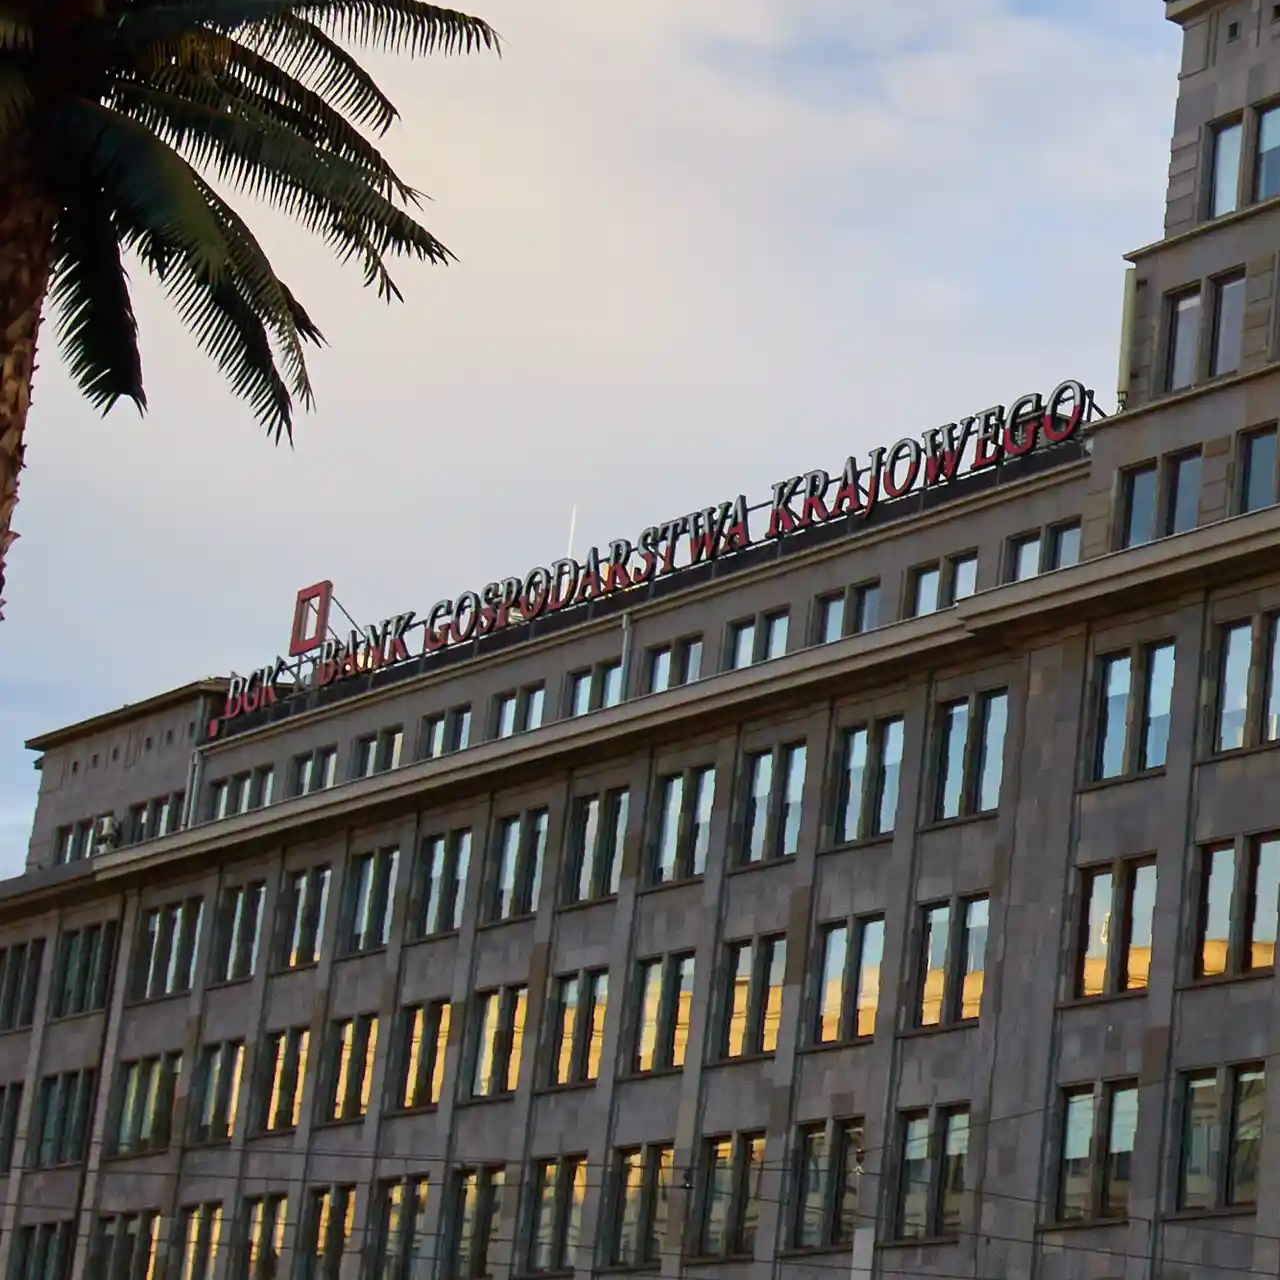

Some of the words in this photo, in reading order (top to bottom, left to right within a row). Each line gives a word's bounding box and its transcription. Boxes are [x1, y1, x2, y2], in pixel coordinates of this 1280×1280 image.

[224, 654, 288, 719] BGK
[316, 611, 416, 686] BANK
[423, 493, 751, 650] GOSPODARSTWA
[765, 379, 1087, 538] KRAJOWEGO
